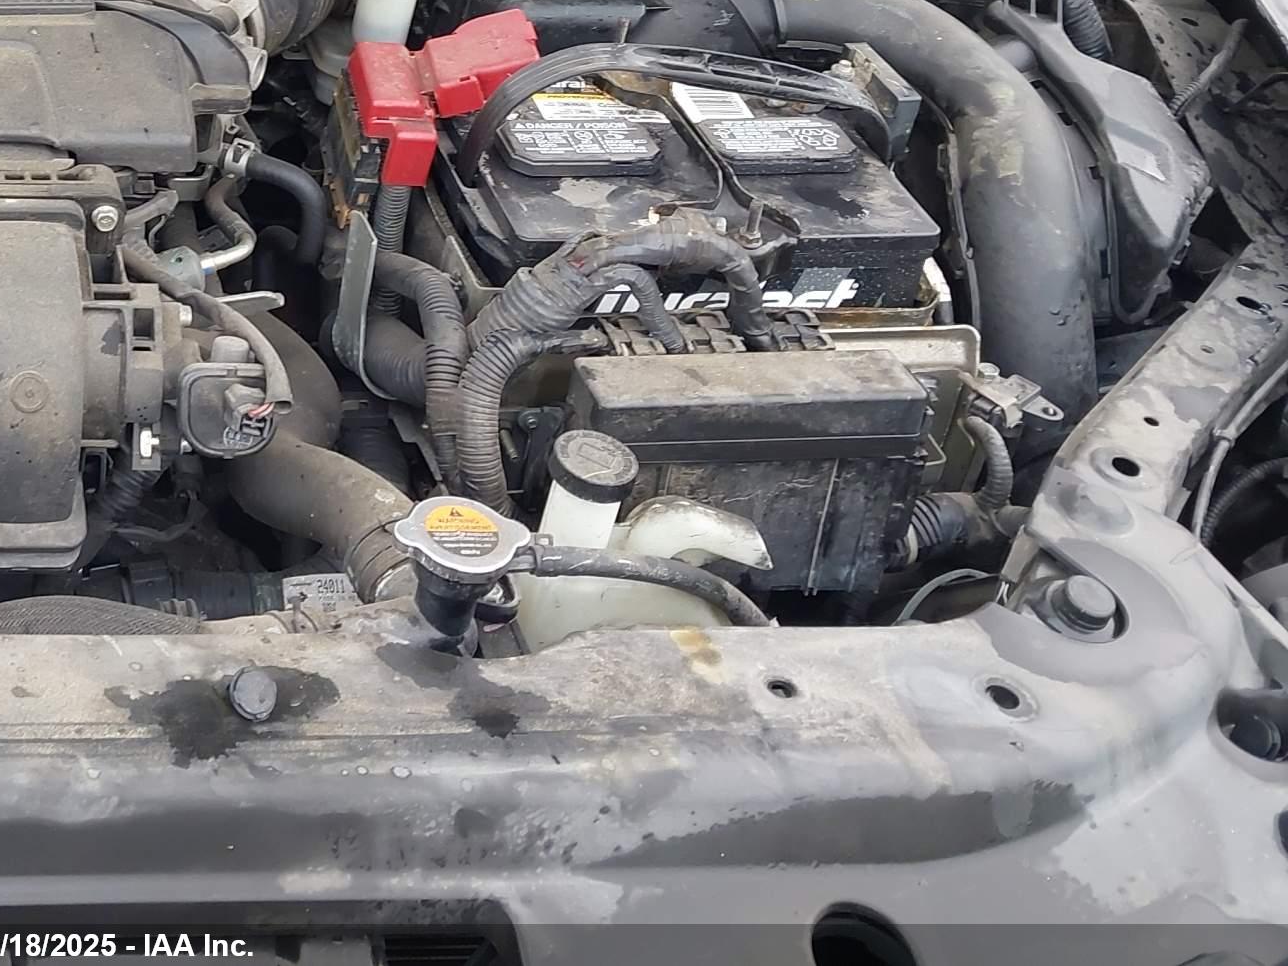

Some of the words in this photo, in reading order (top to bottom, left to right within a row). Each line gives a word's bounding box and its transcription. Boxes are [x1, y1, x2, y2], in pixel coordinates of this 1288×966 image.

[526, 122, 573, 130] DANGER
[583, 122, 628, 130] POISON
[316, 578, 345, 594] 24011
